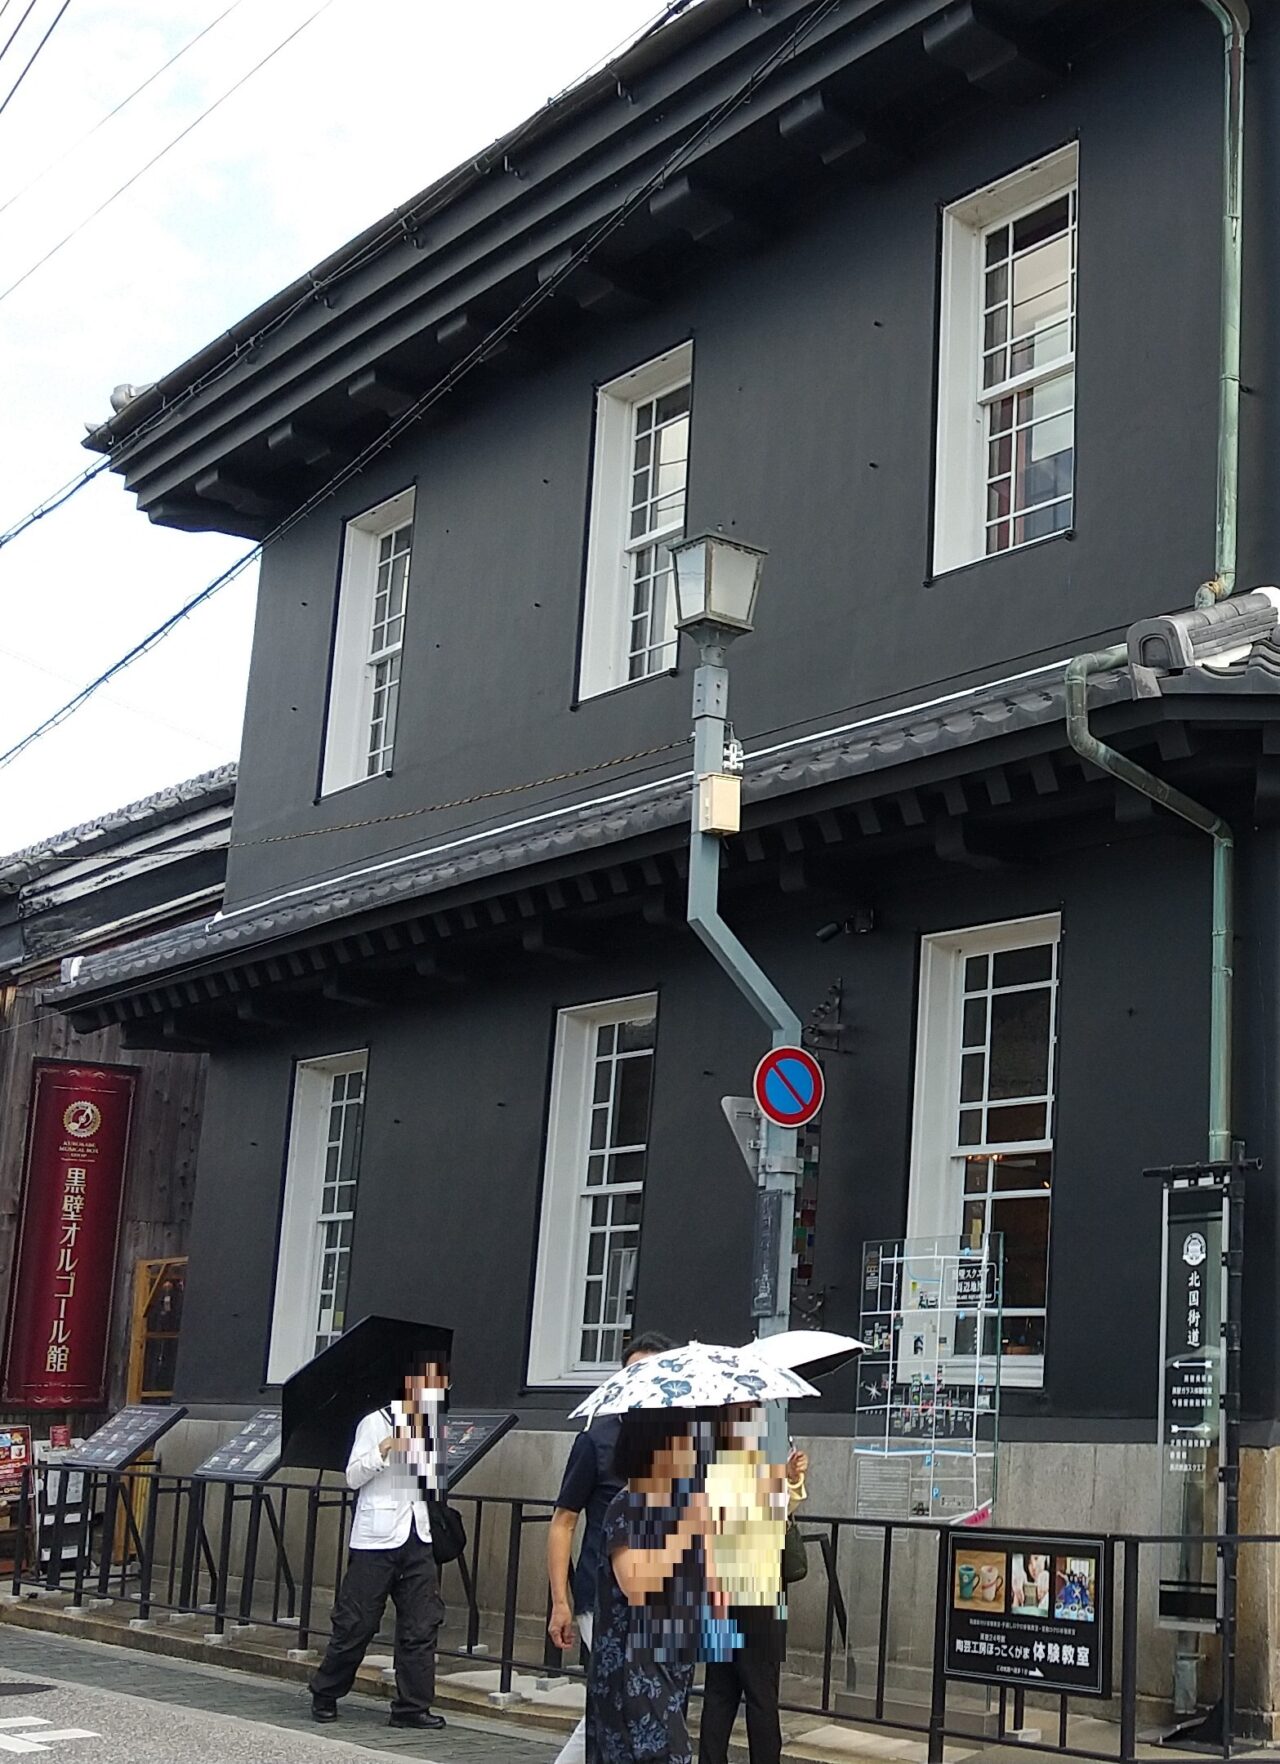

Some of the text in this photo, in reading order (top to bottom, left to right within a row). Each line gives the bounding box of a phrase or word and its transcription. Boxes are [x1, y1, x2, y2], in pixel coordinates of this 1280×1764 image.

[45, 1167, 87, 1373] 黒壁オルゴール館
[1187, 1270, 1201, 1347] 北国街道
[955, 1638, 1090, 1667] 陶芸工房ほっこくがま 体験教室
